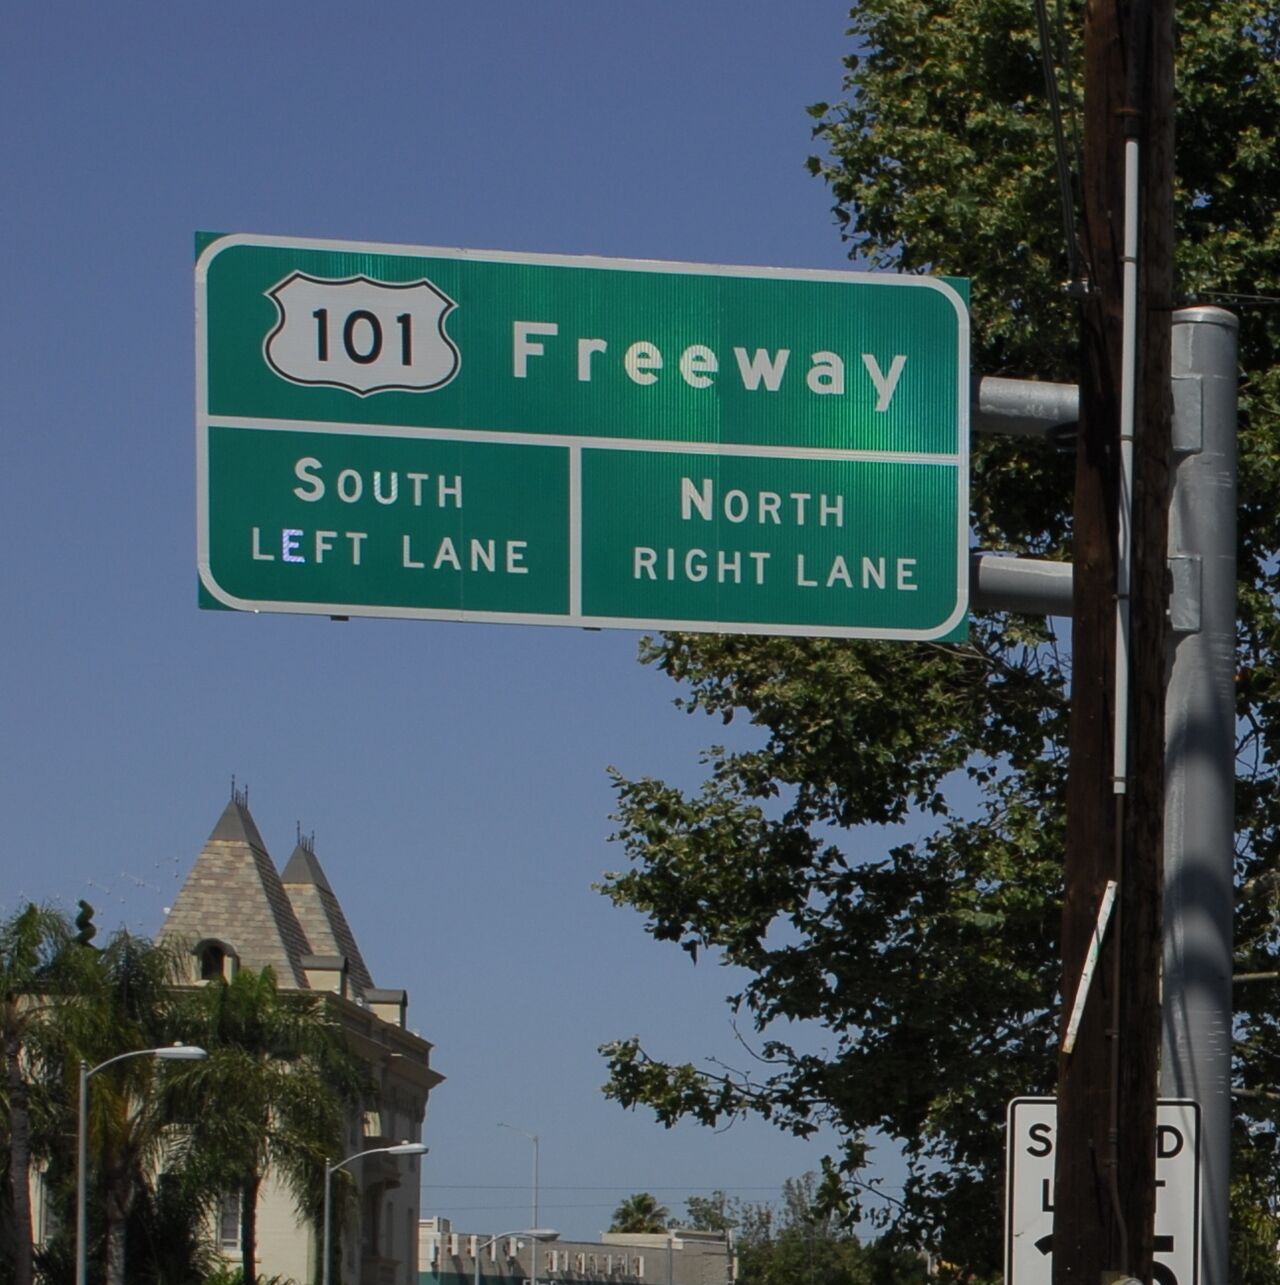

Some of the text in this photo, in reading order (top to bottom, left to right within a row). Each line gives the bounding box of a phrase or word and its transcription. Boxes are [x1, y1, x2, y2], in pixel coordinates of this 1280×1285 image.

[312, 307, 907, 412] 101 Freeway
[251, 526, 530, 575] LEFT LANE
[633, 547, 919, 592] RIGHT LANE
